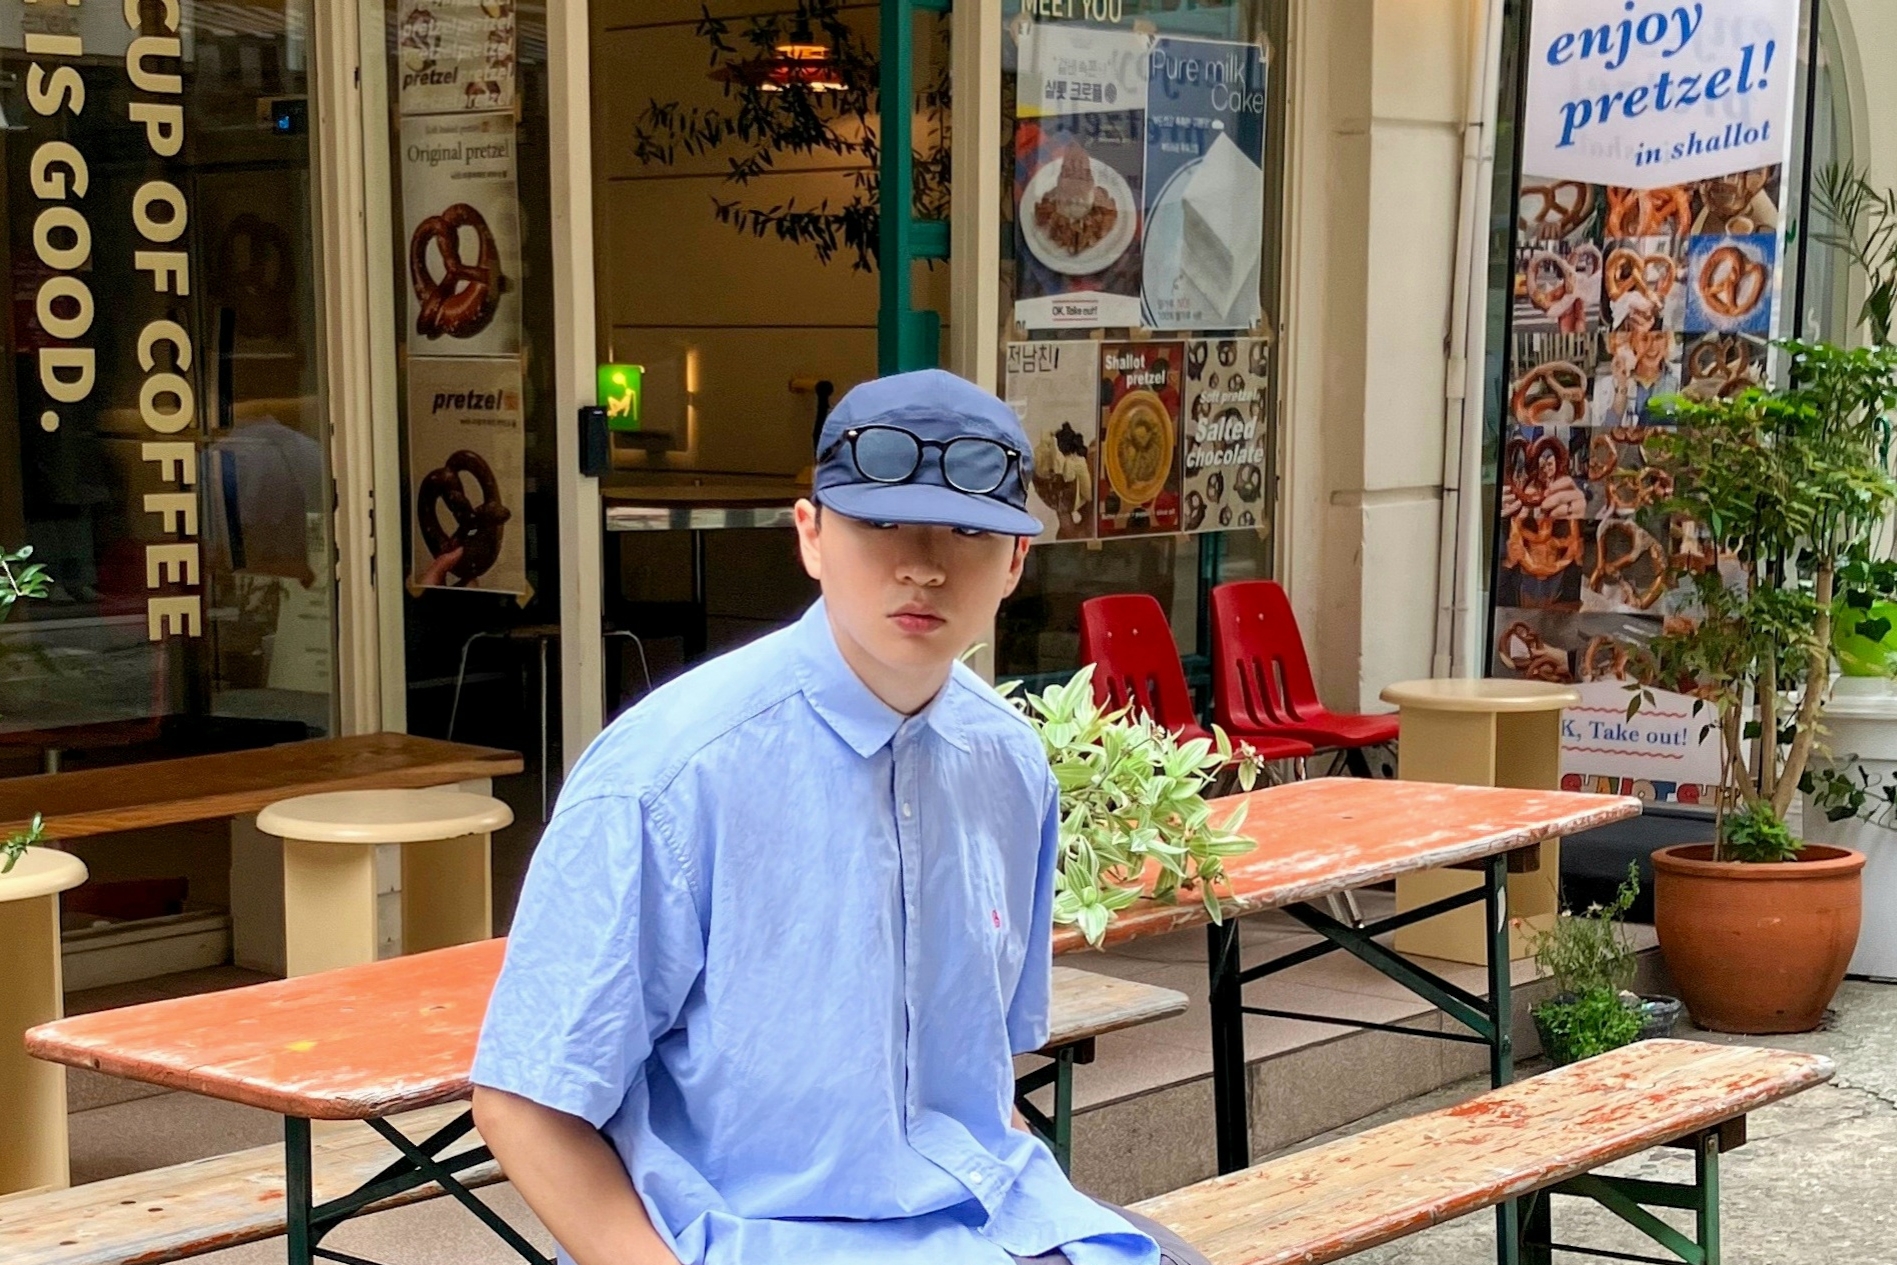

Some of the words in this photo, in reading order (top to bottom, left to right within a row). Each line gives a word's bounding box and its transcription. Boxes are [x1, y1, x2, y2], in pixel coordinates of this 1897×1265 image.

[1546, 0, 1703, 70] enjoy
[25, 33, 86, 116] IS
[124, 0, 183, 157] CUP
[402, 66, 459, 91] pretzel
[1152, 48, 1199, 81] Pure
[1205, 52, 1246, 84] milk
[1212, 83, 1264, 114] Cake
[1555, 40, 1776, 148] pretzel!
[407, 141, 462, 167] Original
[465, 138, 510, 166] pretzel
[1635, 142, 1660, 167] in
[1671, 120, 1770, 160] shallot
[132, 181, 189, 296] OF
[30, 141, 96, 432] GOOD.
[1065, 306, 1081, 315] Take
[1105, 354, 1145, 370] Shallot
[1126, 370, 1166, 389] pretzel
[431, 389, 503, 414] pretzel
[1195, 416, 1258, 443] Salted
[1186, 446, 1264, 468] chocolate
[137, 320, 202, 641] COFFEE
[1589, 721, 1640, 742] Take
[1646, 727, 1688, 746] out!
